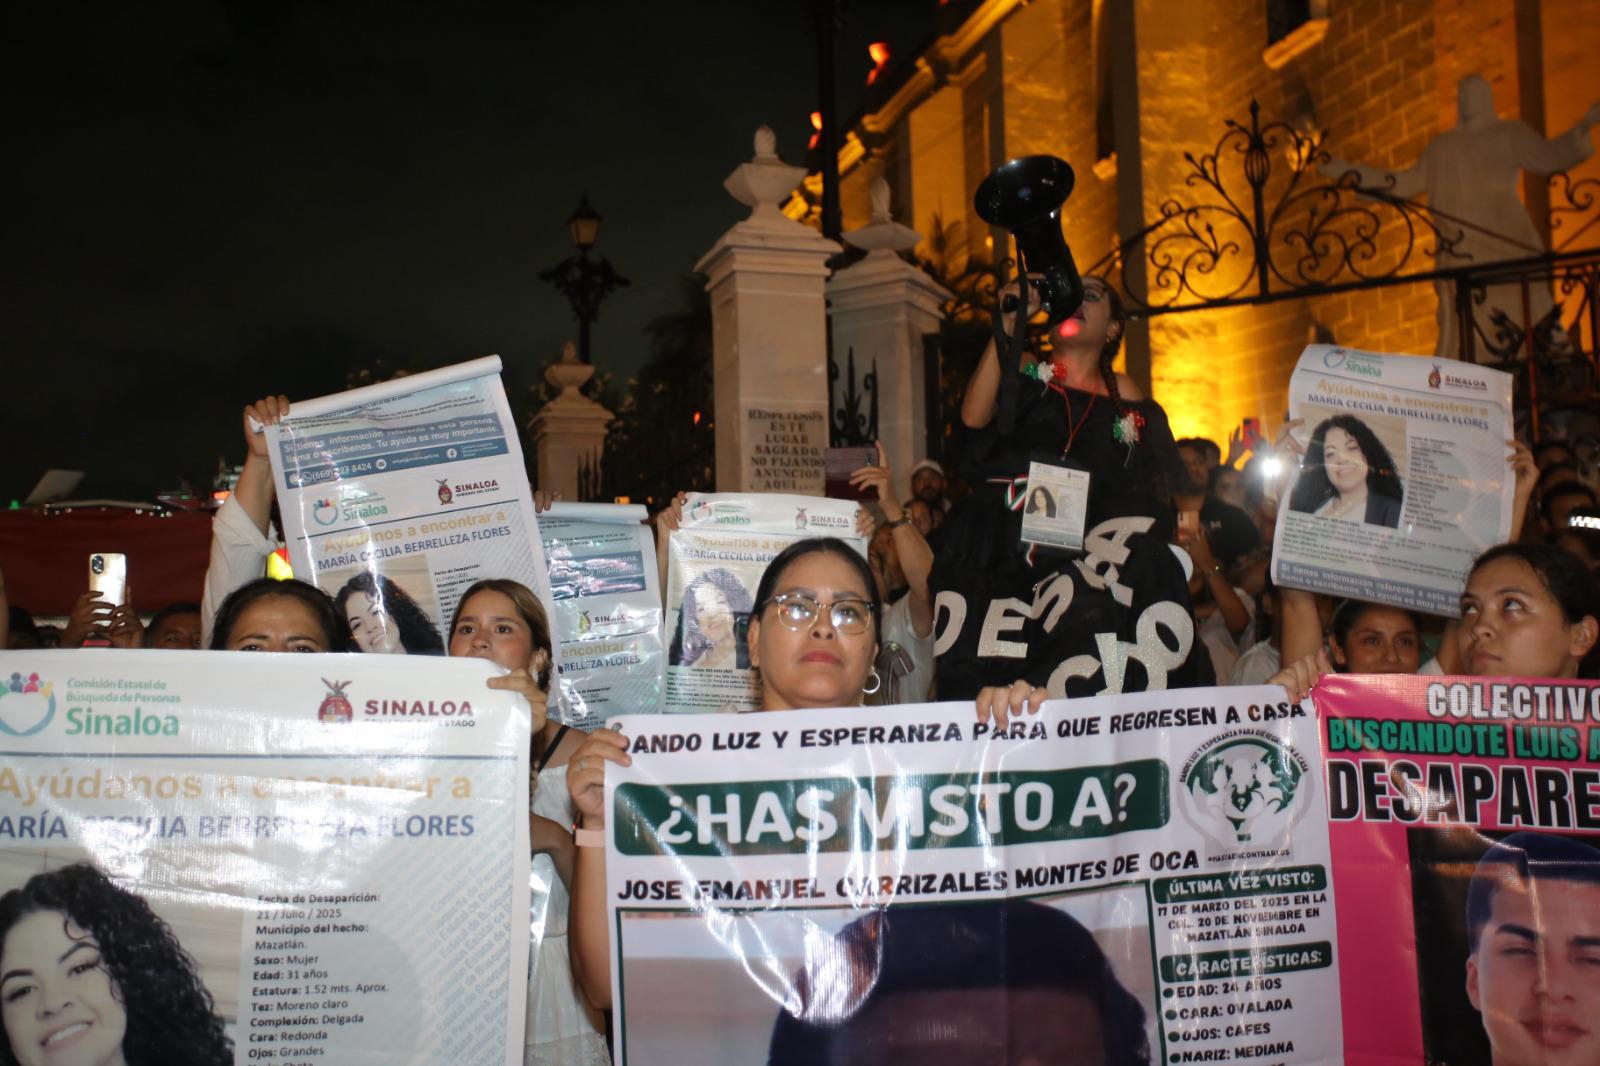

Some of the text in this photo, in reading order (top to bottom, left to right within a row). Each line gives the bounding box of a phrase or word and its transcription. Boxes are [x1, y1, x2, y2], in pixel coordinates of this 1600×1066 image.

[1452, 415, 1488, 430] FLORES
[329, 430, 384, 444] información
[390, 436, 417, 446] ayuda
[432, 431, 450, 440] muy
[765, 434, 808, 444] LUGAR
[352, 462, 372, 472] 8424
[752, 456, 766, 466] NO
[754, 468, 820, 479] ANUNCIOS
[455, 480, 498, 492] SINALOA
[408, 526, 416, 536] a
[421, 513, 491, 534] encontrar
[496, 512, 505, 520] a
[810, 516, 849, 524] SINALOA
[318, 526, 512, 570] MARÍA CCILIA BERRELLEZA FLORES
[718, 550, 752, 562] CECILIA
[67, 678, 167, 690] Comisión Estatal de
[66, 691, 181, 704] Búsqueda de Personas
[364, 700, 474, 716] SINALOA
[65, 707, 180, 736] Sinaloa
[712, 731, 760, 751] LUZ
[772, 731, 788, 749] Y
[800, 722, 962, 747] ESPERANZA
[972, 721, 1048, 742] PARA
[1057, 716, 1102, 738] QUE
[1109, 702, 1218, 734] REGRESEN
[1225, 705, 1242, 724] A
[1248, 701, 1307, 722] CASA
[1327, 717, 1509, 758] BUSCANDOTE
[1514, 724, 1580, 762] LUIS
[0, 767, 203, 807] Ayúdanos
[451, 776, 472, 799] a
[1326, 758, 1600, 831] DESAPARE
[657, 772, 1137, 844] ¿HAS VISTO A?
[376, 814, 474, 838] FLORES
[618, 850, 1200, 900] JOSE EMANUEL CARRIZALES MONTES DE OCA
[1169, 872, 1315, 896] ÚLTIMA VEZ VISTO:
[258, 893, 381, 905] Fecha de Desaparición:
[1158, 892, 1327, 916] 17 DE MARZO DEL 2025 EN LA
[256, 911, 269, 920] 21
[280, 910, 305, 920] Julio
[316, 908, 342, 919] 2025
[1197, 916, 1212, 927] 20
[1215, 915, 1229, 926] DE
[1233, 910, 1302, 924] NOVIEMBRE
[1306, 908, 1320, 918] EN
[256, 924, 369, 936] Municipio del hecho:
[1186, 922, 1306, 942] MAZATLÁN SINALOA
[254, 955, 319, 966] Sexo: Mujer
[1176, 950, 1322, 976] CARACTERÍSTICAS:
[253, 969, 328, 980] Edad: 31 años
[252, 983, 390, 996] Estatura: 1.52 mts. Aprox.
[1176, 976, 1282, 998] EDAD: 24 AÑOS
[251, 1000, 348, 1012] Tez: Moreno claro
[1180, 998, 1292, 1019] CARA: OVALADA
[250, 1014, 364, 1028] Complexión: Delgada
[250, 1030, 328, 1042] Cara: Redonda
[1182, 1022, 1271, 1042] OJOS: CAFES
[248, 1046, 324, 1060] Ojos: Grandes
[1182, 1041, 1294, 1062] NARIZ: MEDIANA
